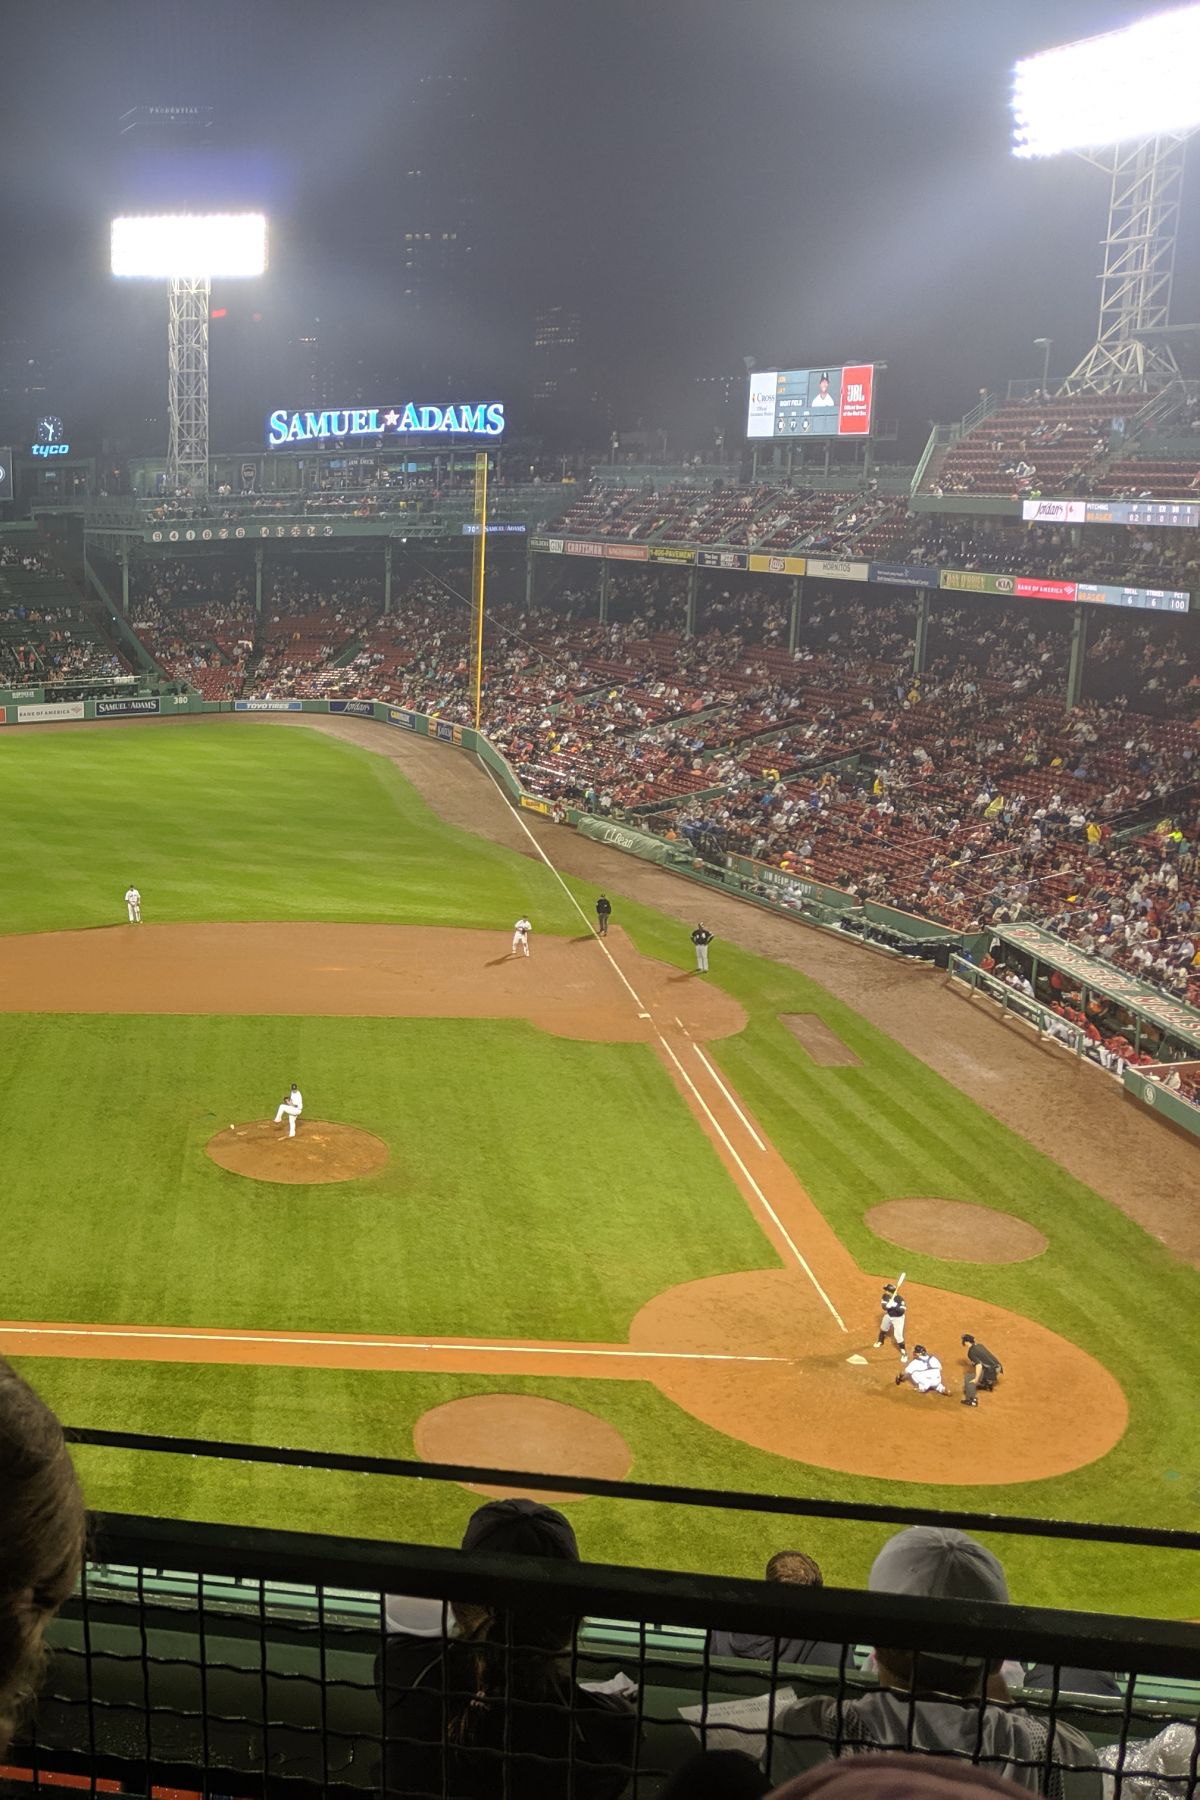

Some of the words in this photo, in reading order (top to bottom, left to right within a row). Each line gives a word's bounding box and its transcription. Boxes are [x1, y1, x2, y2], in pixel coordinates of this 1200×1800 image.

[269, 409, 385, 445] SAMUEL
[396, 402, 505, 435] ADAMS
[31, 443, 70, 458] tyco
[567, 543, 603, 555] CRAFTSMAN
[822, 562, 851, 573] HORNITOS
[996, 579, 1013, 589] KIA
[1017, 583, 1031, 591] BANK
[1040, 586, 1063, 594] AMERICA
[1171, 599, 1185, 609] 100
[99, 702, 127, 712] SAMUEL
[130, 700, 157, 709] ADAMS
[172, 696, 188, 705] 380
